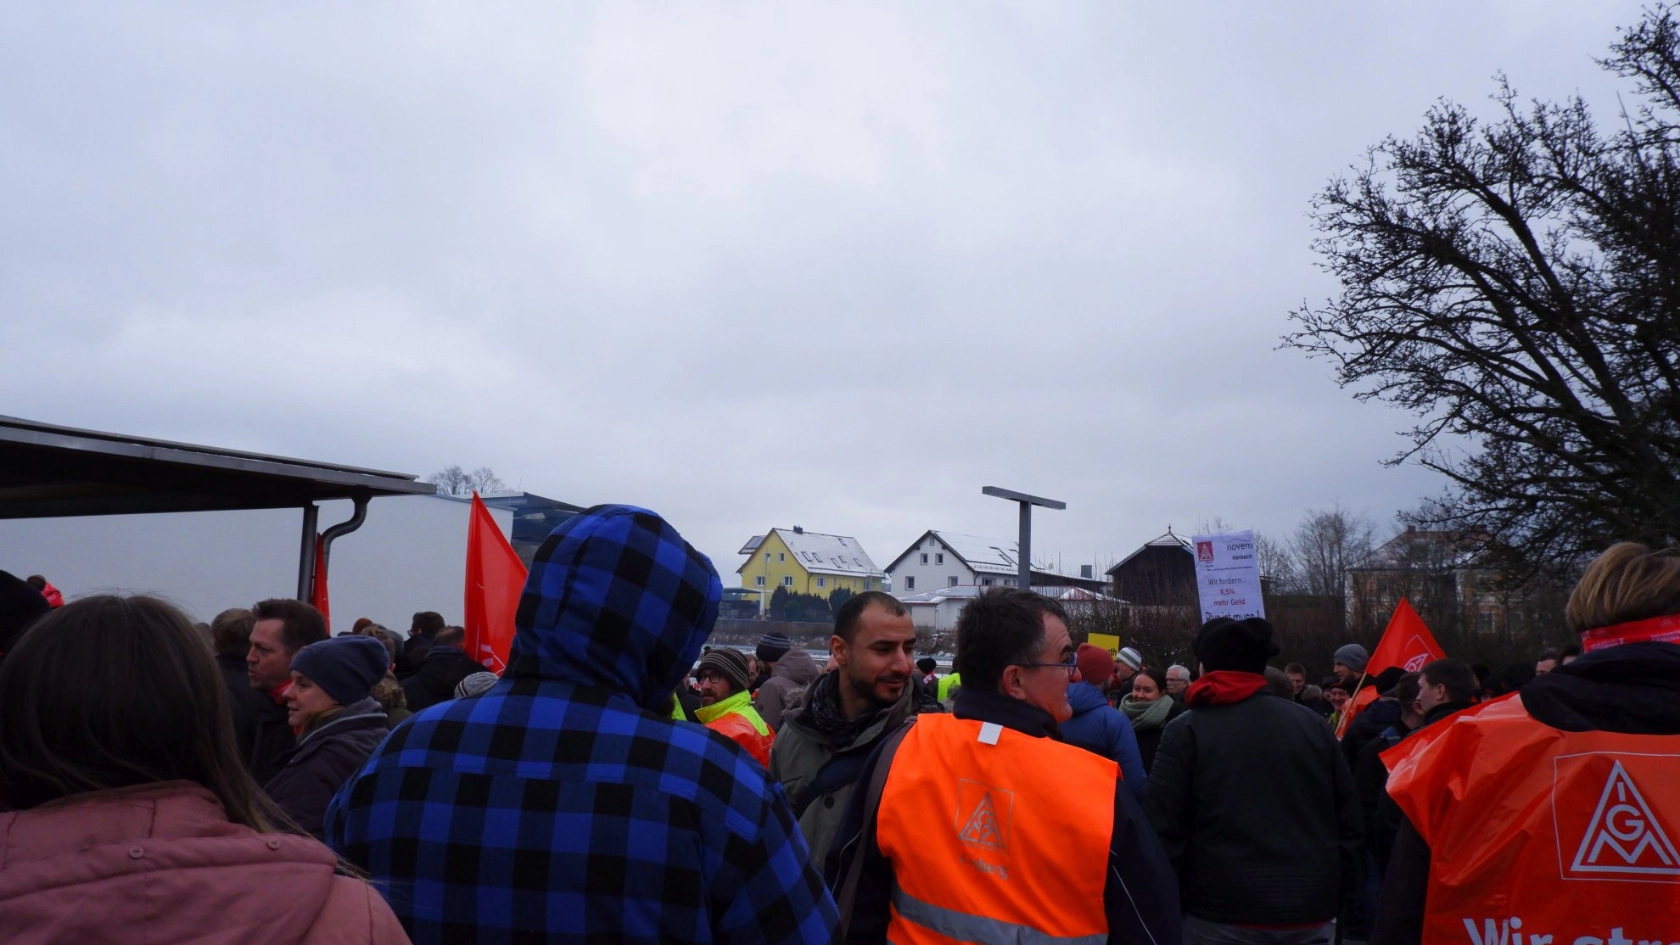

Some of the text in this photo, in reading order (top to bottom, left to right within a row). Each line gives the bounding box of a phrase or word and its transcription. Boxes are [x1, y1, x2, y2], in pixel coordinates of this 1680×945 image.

[1226, 543, 1253, 551] novem
[1219, 577, 1242, 585] fordern
[1230, 598, 1246, 606] Geld
